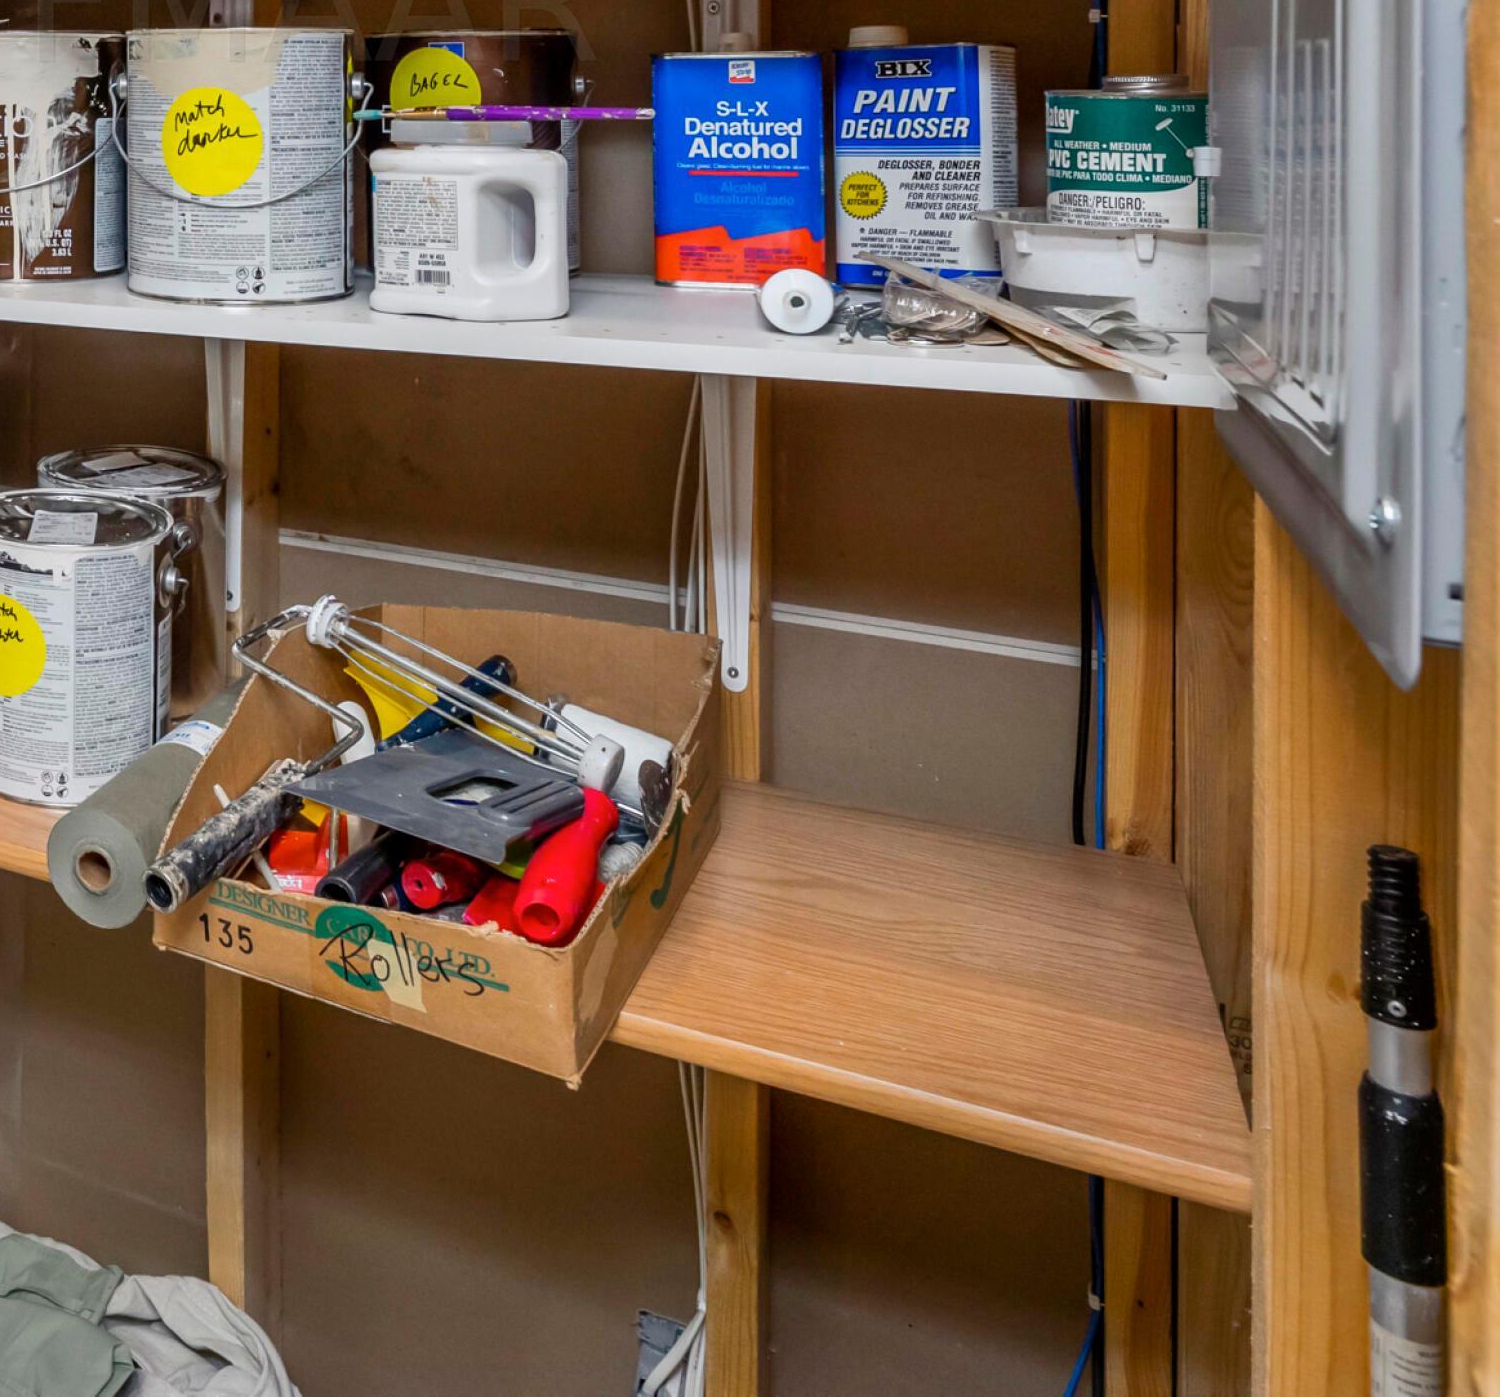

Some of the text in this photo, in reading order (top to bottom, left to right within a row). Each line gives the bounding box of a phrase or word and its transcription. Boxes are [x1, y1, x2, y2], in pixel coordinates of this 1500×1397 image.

[875, 57, 933, 79] BIX
[853, 87, 957, 115] PAINT
[716, 100, 770, 117] S-L-X
[1171, 104, 1196, 113] 31133
[684, 117, 803, 137] Denatured
[840, 117, 972, 141] DEGLOSSER
[688, 136, 799, 160] Alcohol
[1054, 140, 1152, 151] ALL WEATHER MEDIUM
[878, 159, 981, 171] DEGLOSSER, BONDER
[1049, 149, 1167, 173] PVC CEMENT
[911, 171, 981, 182] AND CLEANER
[1073, 171, 1091, 181] PARA
[1092, 172, 1114, 182] TODO
[1115, 173, 1143, 183] CLIMA
[1152, 174, 1192, 184] MEDIANO
[720, 181, 768, 194] Alcohol
[847, 183, 878, 191] PERFECT
[898, 182, 981, 192] PREPARES SURFACE
[855, 191, 870, 199] FOR
[907, 192, 924, 201] FOR
[904, 201, 943, 211] REMOVES
[924, 211, 957, 221] OIL AND
[868, 227, 953, 239] DANGER FLAMMABLE
[860, 236, 885, 244] HARMFUL
[869, 242, 894, 251] HARMFUL
[215, 881, 310, 925] DESIGNER
[198, 911, 254, 955] 135
[318, 922, 485, 997] Rollers
